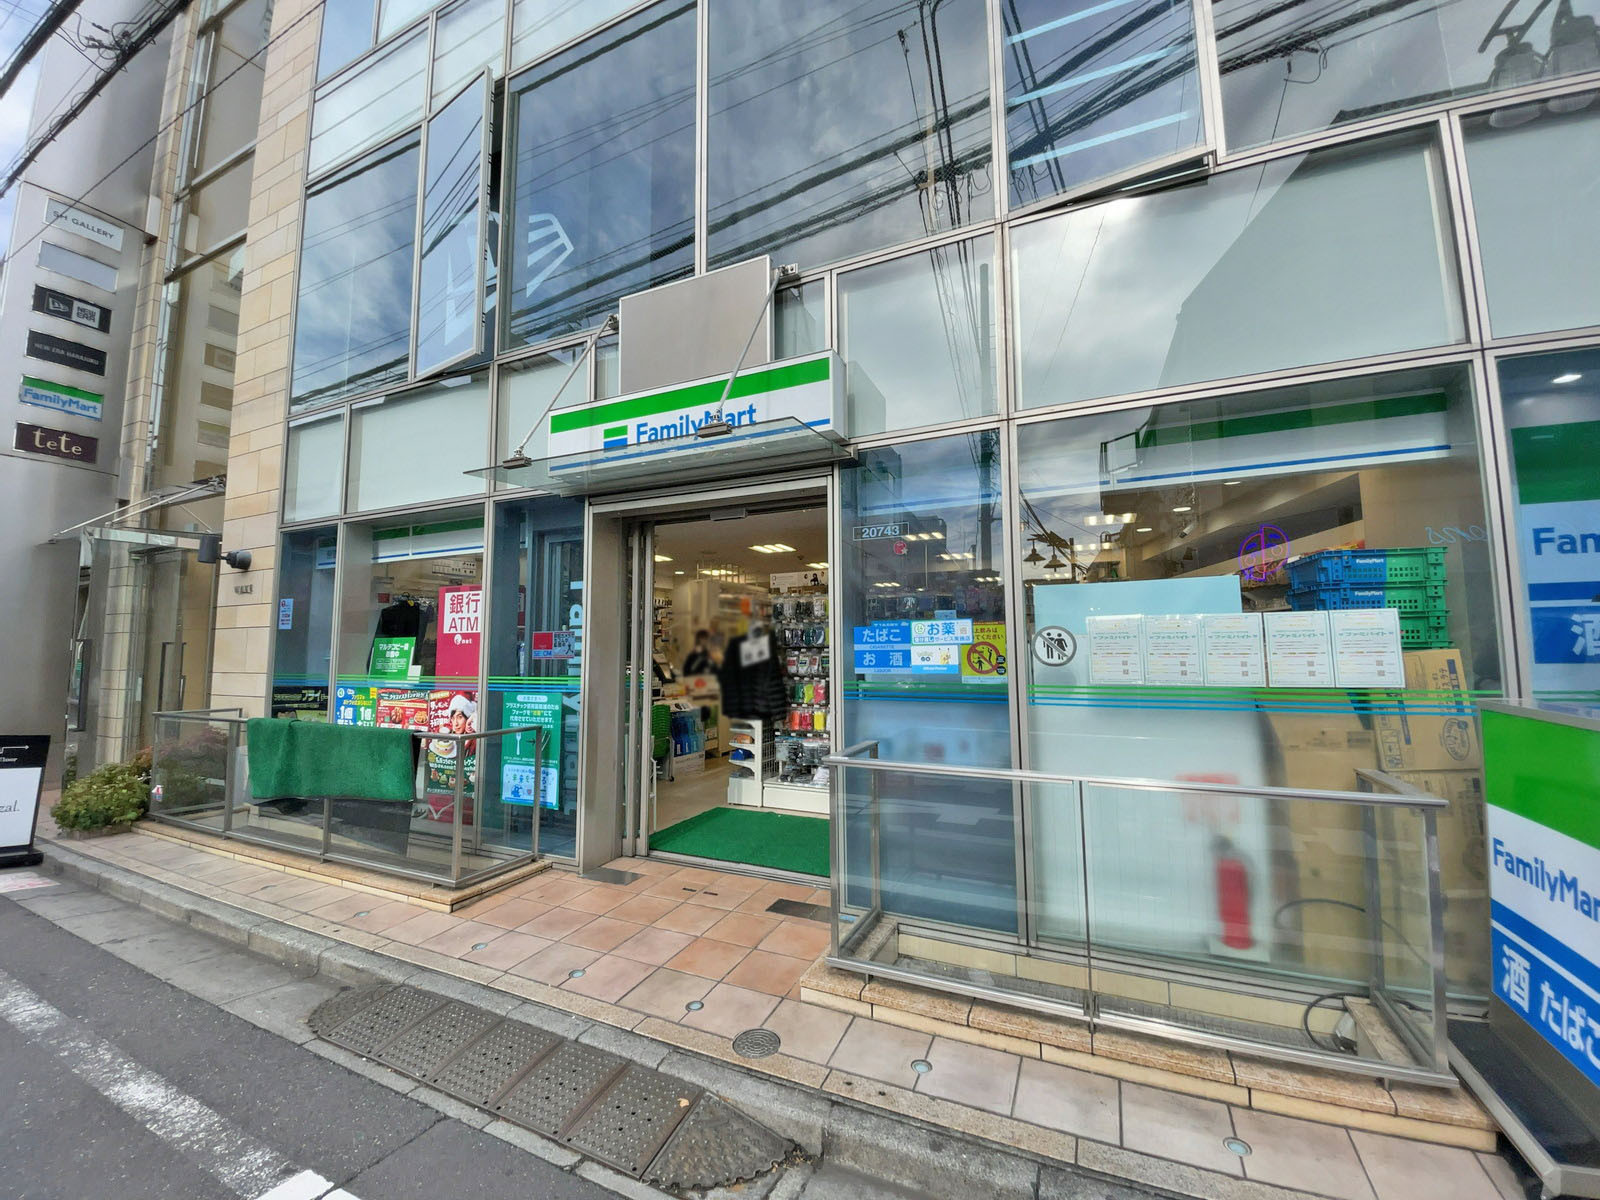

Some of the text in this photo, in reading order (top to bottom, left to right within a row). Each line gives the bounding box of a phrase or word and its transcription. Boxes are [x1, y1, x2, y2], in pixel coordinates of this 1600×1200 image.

[71, 217, 115, 240] GALLERY
[76, 306, 97, 317] NEW
[76, 312, 97, 323] ERA
[23, 387, 98, 414] FamilyMart
[32, 427, 83, 456] tete
[861, 526, 900, 538] 20743
[449, 592, 481, 614] 銀行
[448, 616, 479, 632] ATM
[927, 622, 956, 636] お薬
[862, 628, 902, 643] たばこ
[1502, 943, 1531, 1014] 酒
